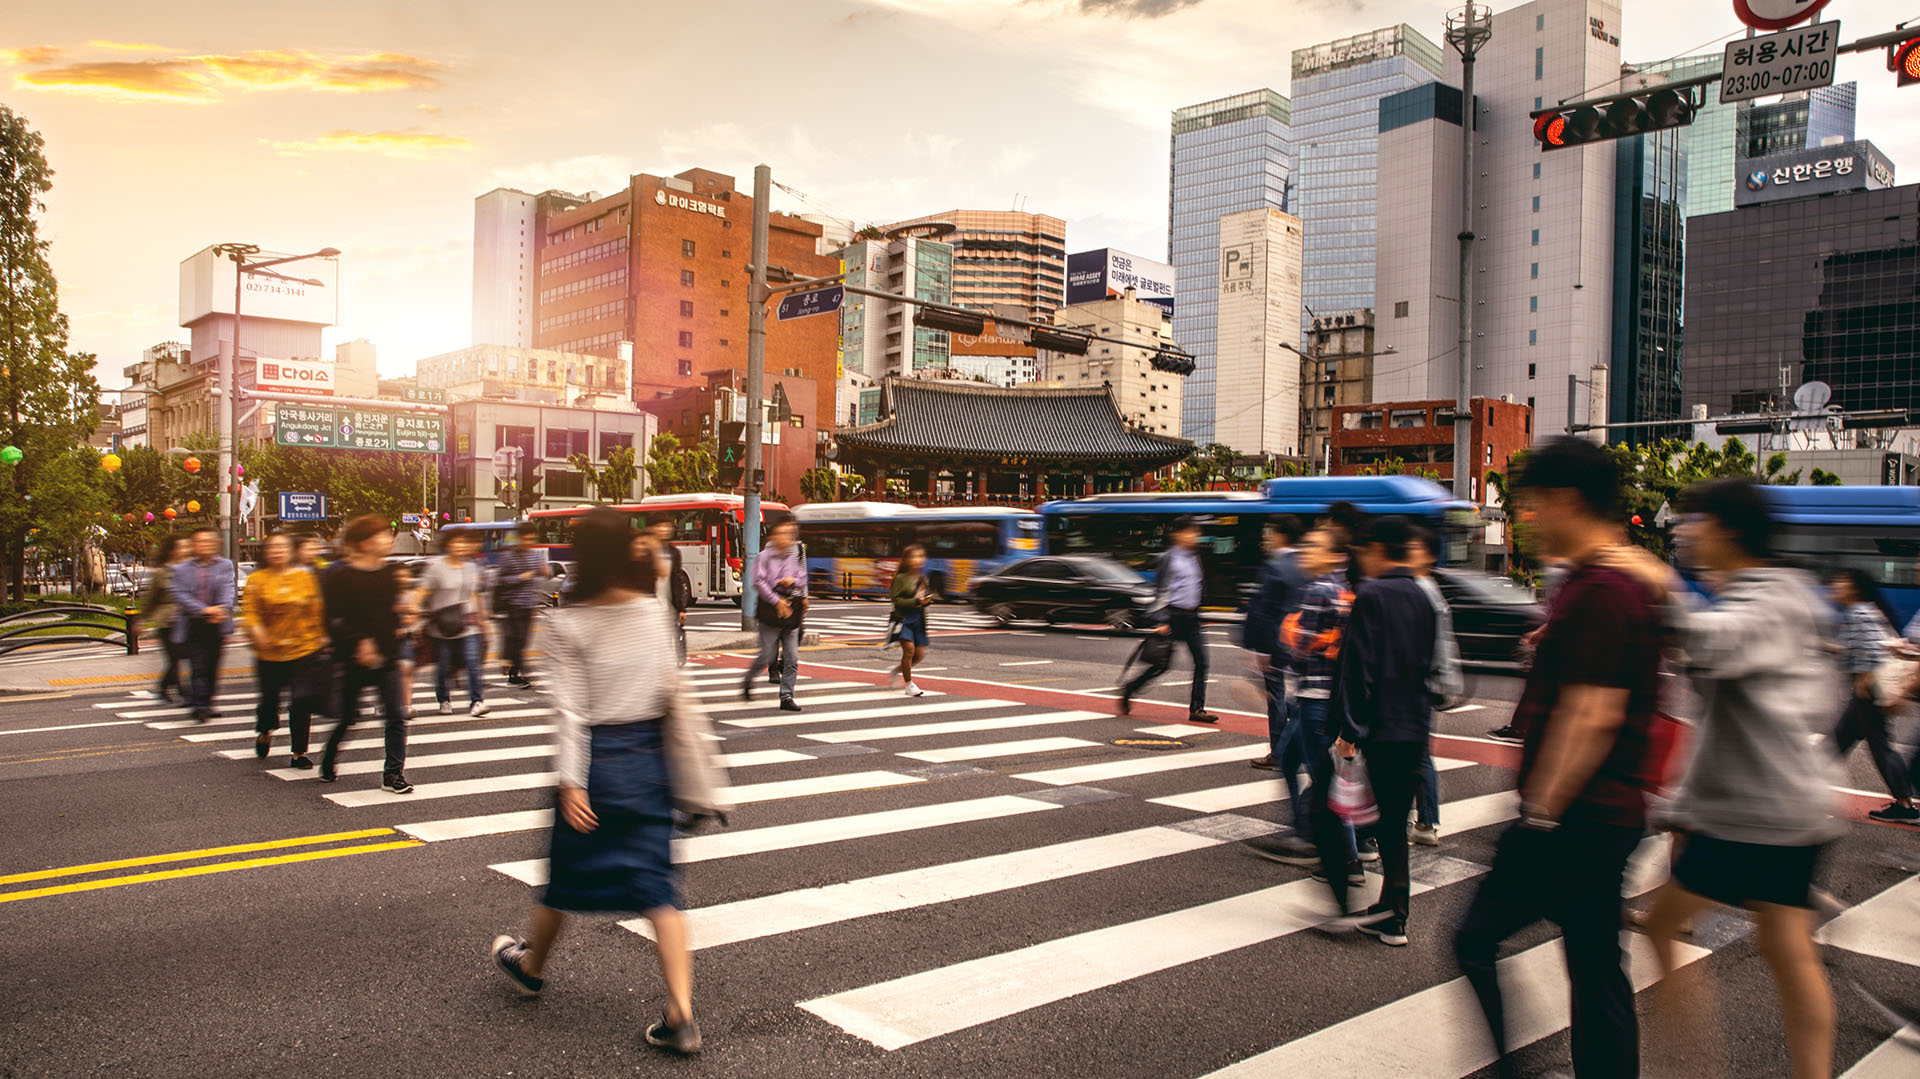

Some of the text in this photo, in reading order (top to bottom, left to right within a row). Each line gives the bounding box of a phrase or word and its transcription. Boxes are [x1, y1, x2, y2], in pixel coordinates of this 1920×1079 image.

[1734, 29, 1830, 66] 허용시간
[1726, 60, 1830, 96] 23:00~07:00
[1772, 156, 1854, 185] 신한은행
[669, 194, 726, 218] 마이크임팩트
[1112, 255, 1132, 272] 연금은
[1226, 250, 1240, 278] P
[803, 293, 819, 306] 종로
[831, 294, 841, 303] 47
[781, 303, 789, 313] 51
[978, 334, 1024, 345] Hanw
[282, 367, 329, 382] 다이소
[407, 389, 442, 401] 종로1가
[279, 409, 333, 423] 안국동사거리
[281, 421, 332, 432] Angukdong Jct
[396, 417, 440, 430] 을지로1가
[355, 437, 390, 449] 종로2가
